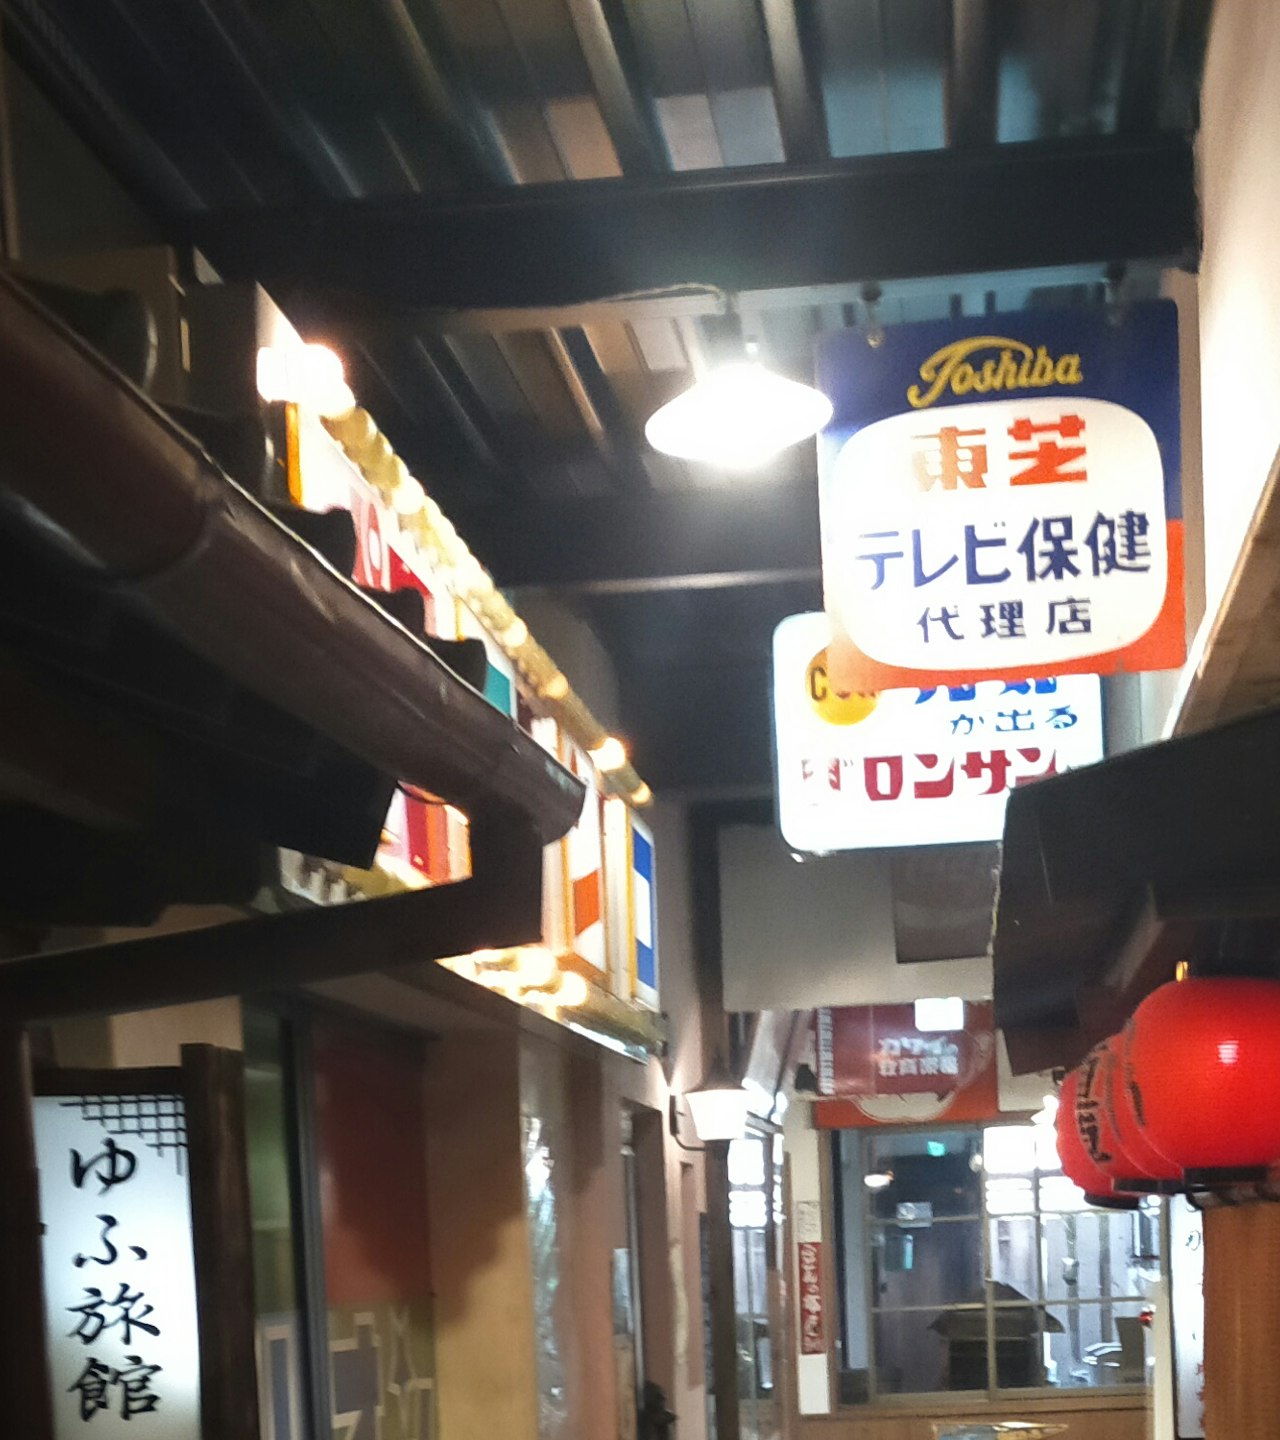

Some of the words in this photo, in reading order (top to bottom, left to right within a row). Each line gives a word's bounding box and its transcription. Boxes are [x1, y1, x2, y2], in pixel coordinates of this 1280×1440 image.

[907, 335, 1083, 408] Toshiba
[910, 415, 1087, 491] 東芝
[855, 509, 1151, 590] テレビ保健
[916, 596, 1091, 643] 代理店
[65, 1136, 163, 1422] ゆふ旅館
